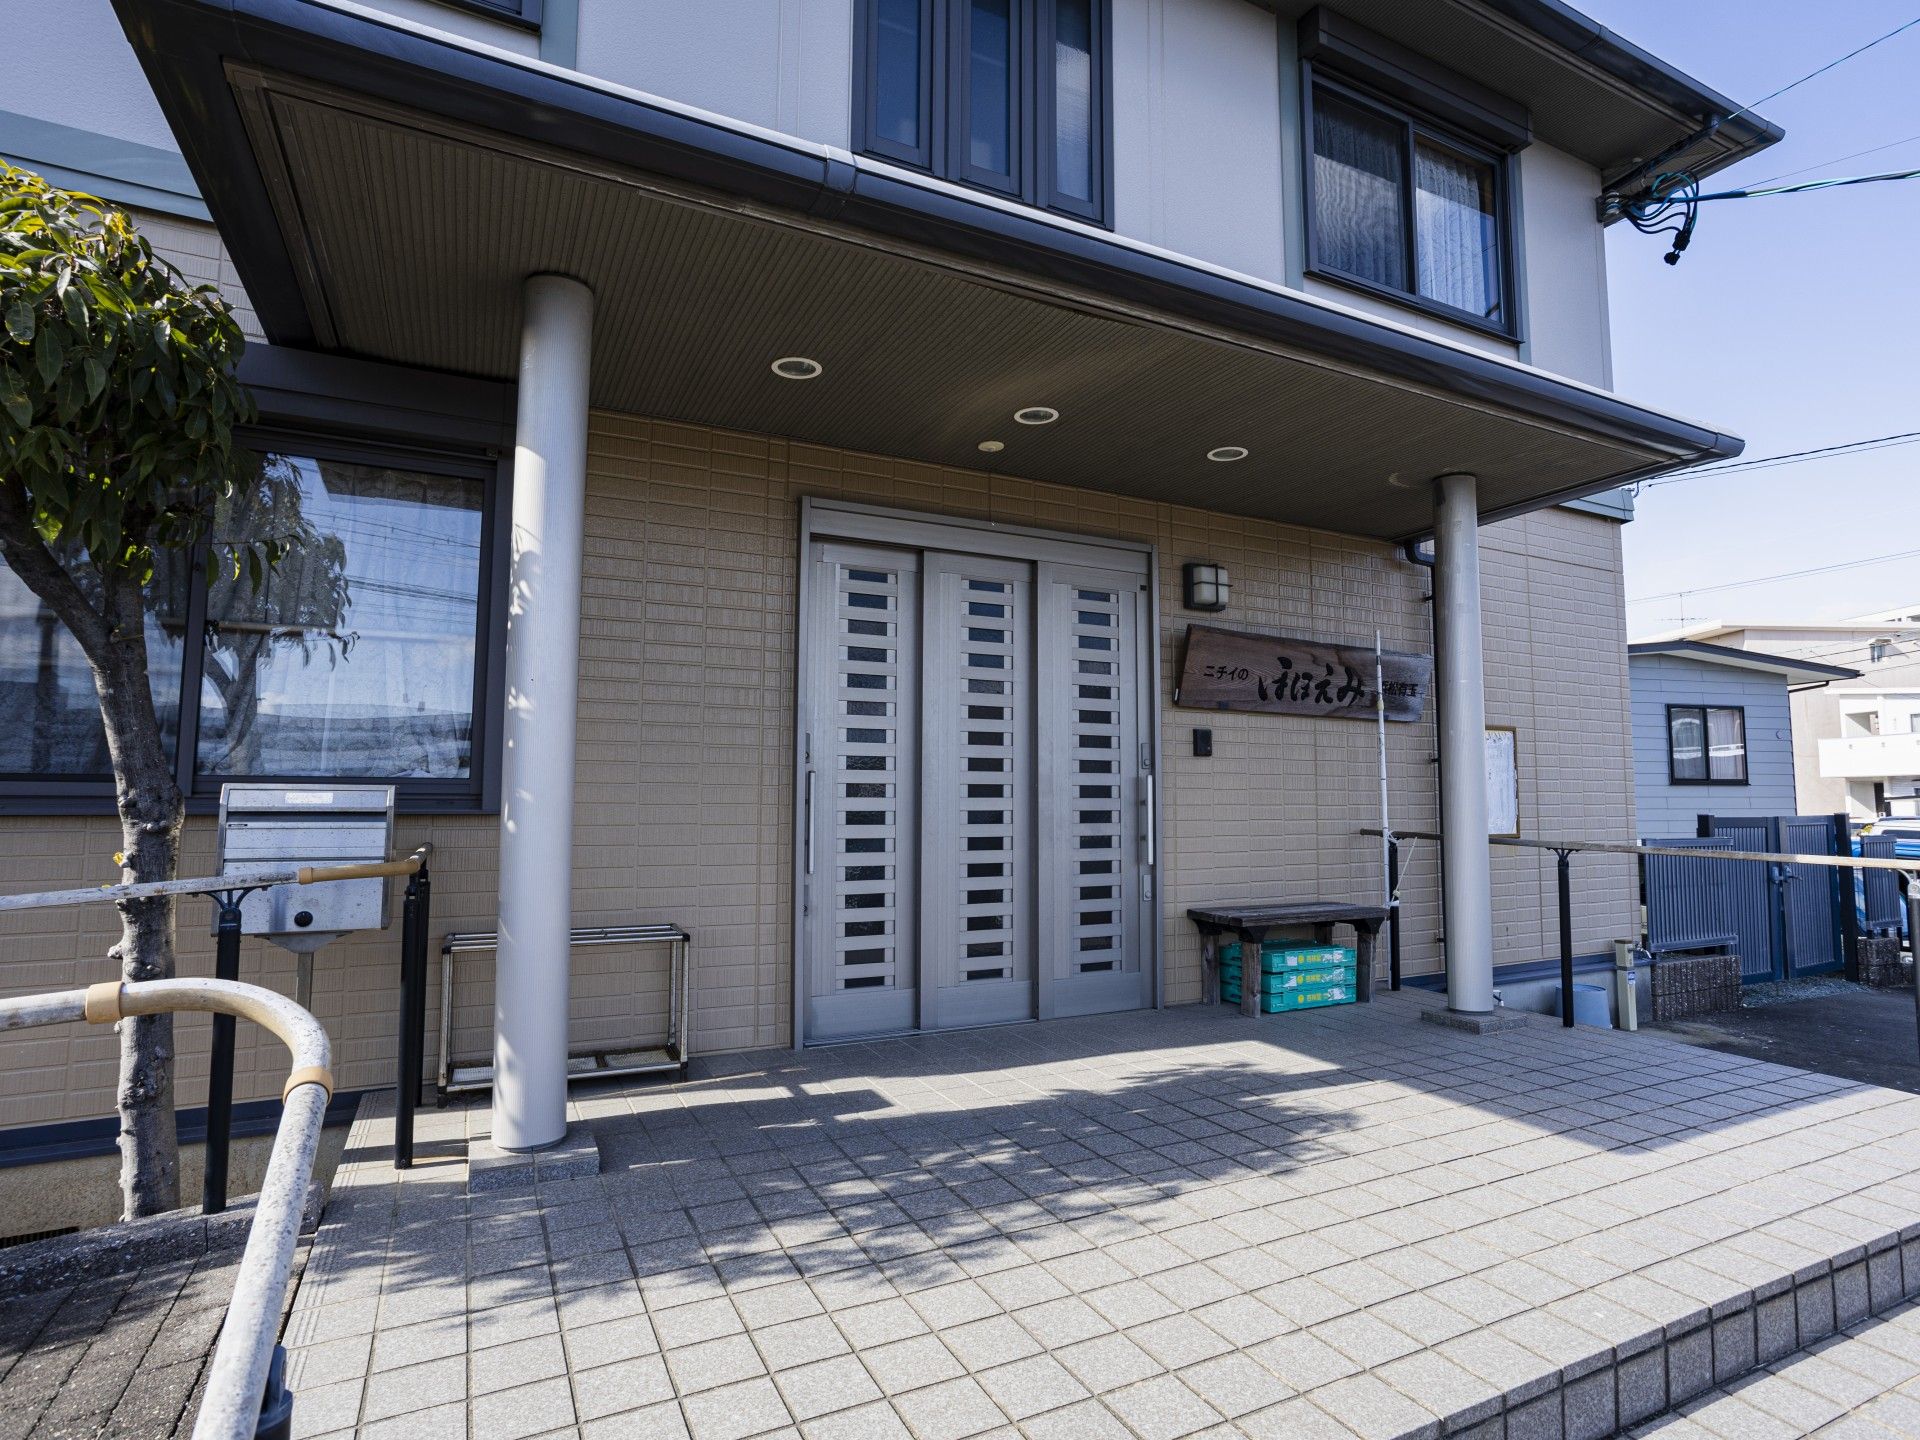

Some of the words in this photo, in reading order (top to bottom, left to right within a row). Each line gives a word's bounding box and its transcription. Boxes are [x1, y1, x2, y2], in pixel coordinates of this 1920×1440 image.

[1203, 665, 1249, 681] ニチイの
[1257, 656, 1365, 707] ほほえみ
